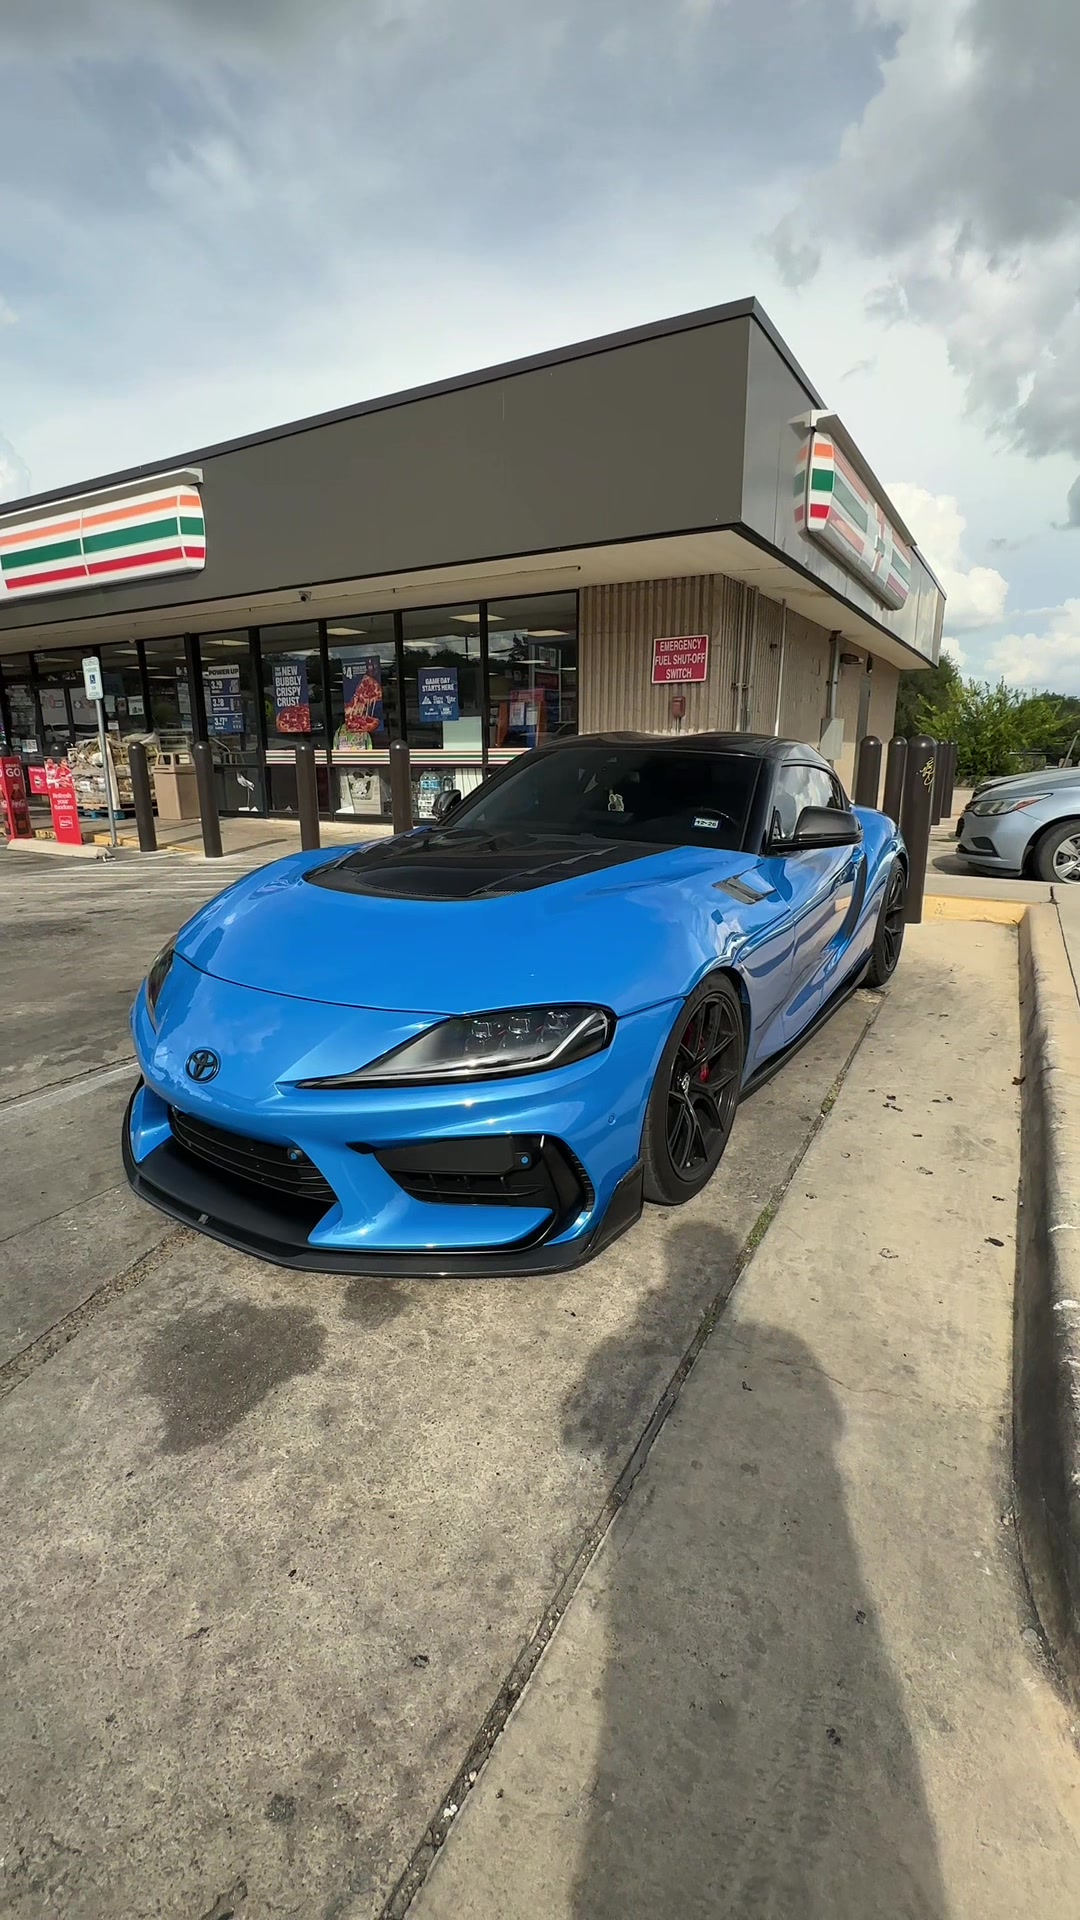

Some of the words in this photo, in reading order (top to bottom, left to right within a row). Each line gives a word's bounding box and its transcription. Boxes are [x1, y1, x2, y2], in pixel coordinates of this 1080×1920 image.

[660, 638, 702, 652] EMERGENCY
[655, 655, 672, 666] FUEL
[673, 652, 706, 665] SHUT-OFF
[281, 666, 298, 676] NEW
[342, 666, 353, 680] $4
[665, 668, 692, 680] SWITCH
[275, 676, 302, 686] BUBBLY
[276, 686, 302, 697] CRISPY
[277, 696, 300, 707] CRUST
[5, 767, 21, 778] GO
